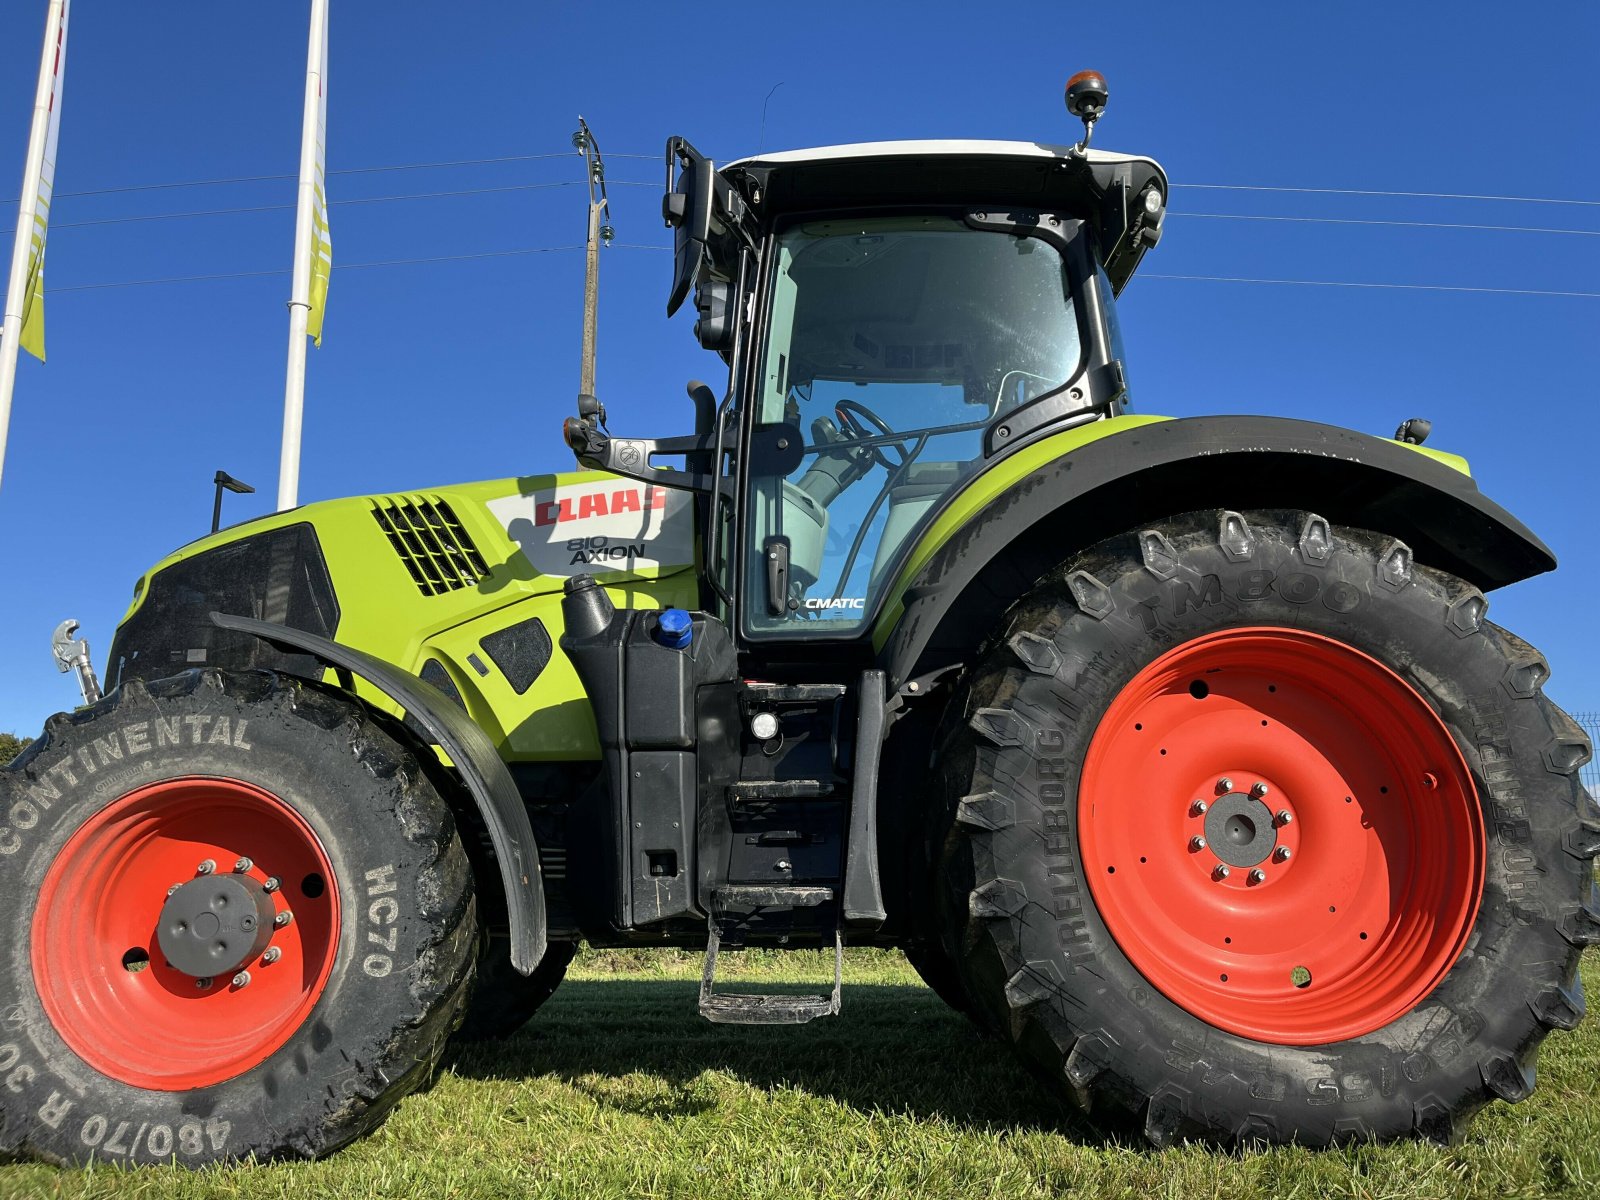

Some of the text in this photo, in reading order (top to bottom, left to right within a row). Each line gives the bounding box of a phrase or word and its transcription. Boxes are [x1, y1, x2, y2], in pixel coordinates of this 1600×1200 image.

[535, 486, 667, 527] CLAAS
[567, 535, 609, 551] 810
[569, 543, 645, 565] AXION
[805, 597, 866, 609] CMATIC
[1127, 569, 1361, 635] TM800
[0, 714, 252, 855] CONTINENTAL
[1035, 729, 1096, 976] TRELLEBORG
[363, 863, 399, 978] HC70
[38, 1089, 73, 1130] R
[80, 1113, 232, 1158] 480/70
